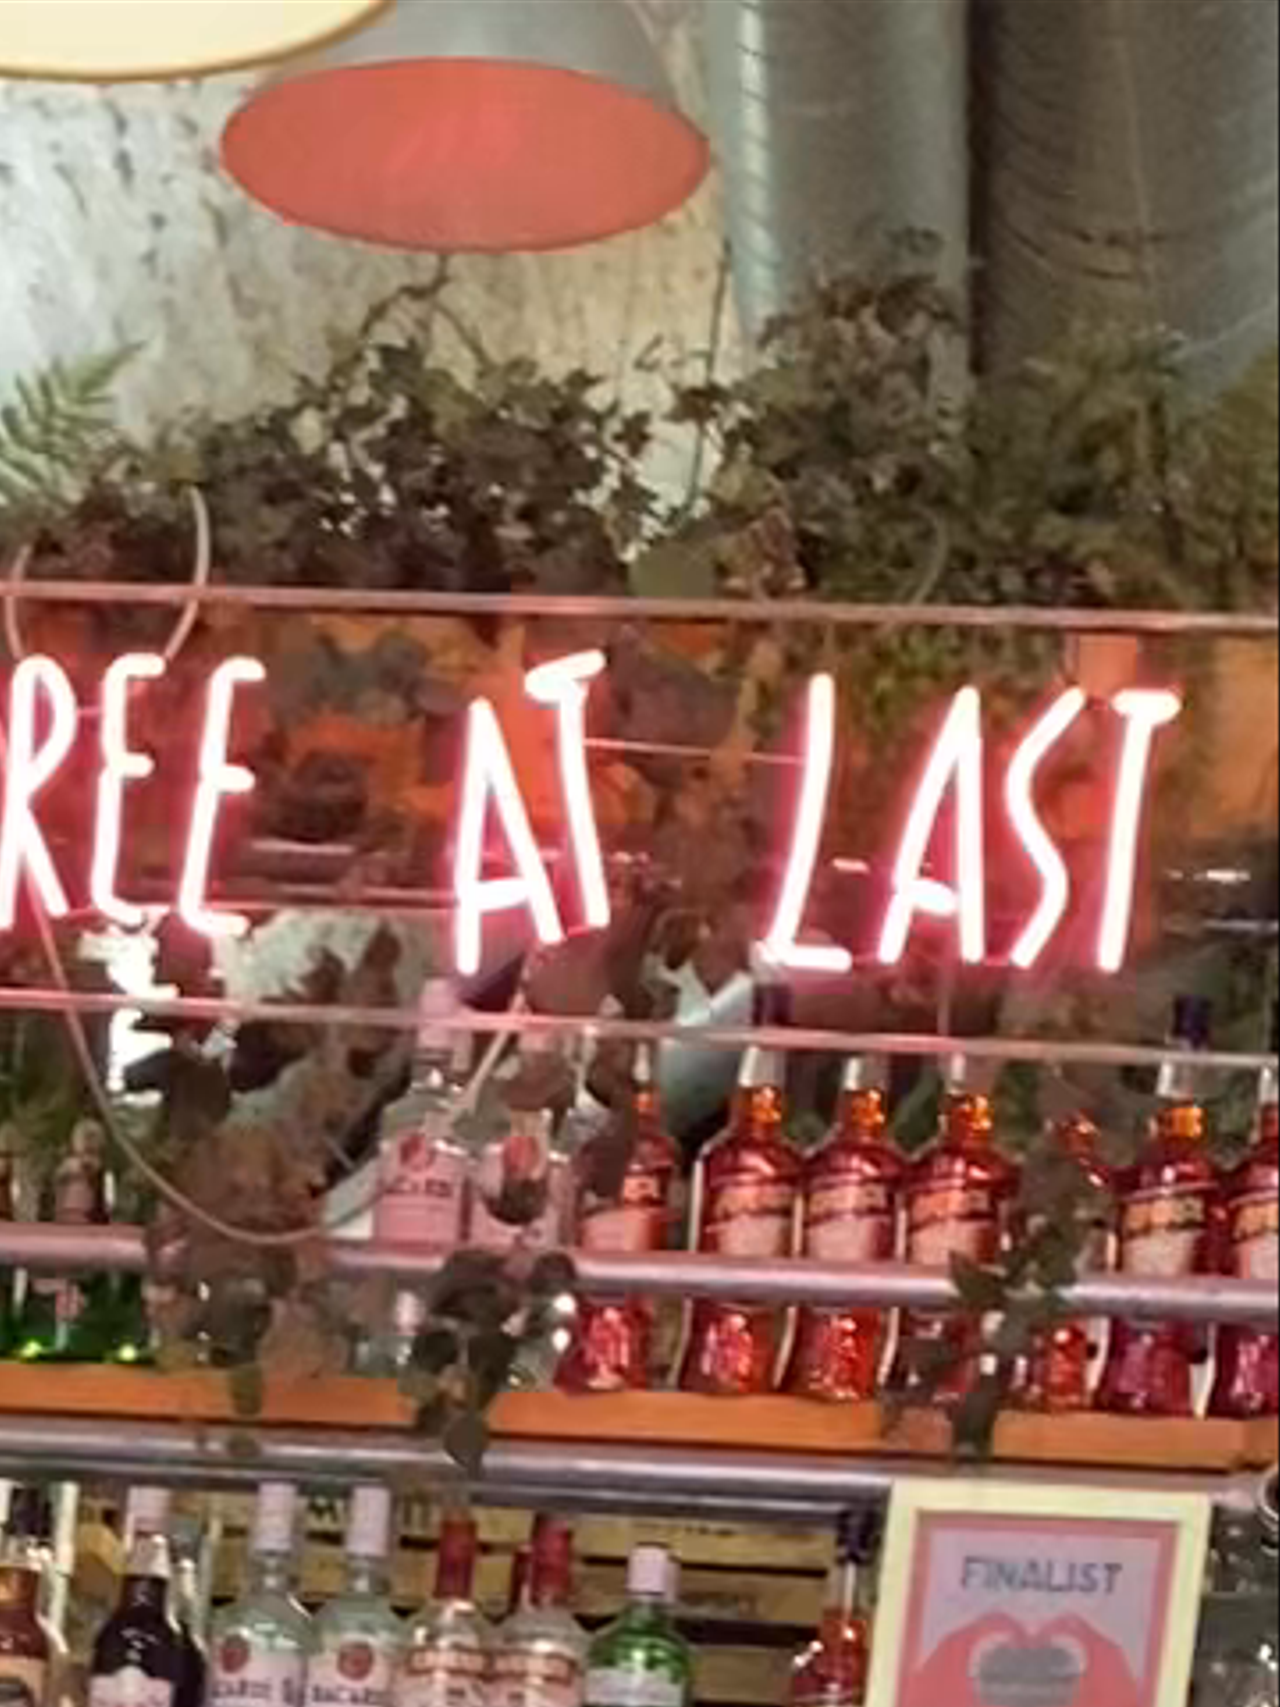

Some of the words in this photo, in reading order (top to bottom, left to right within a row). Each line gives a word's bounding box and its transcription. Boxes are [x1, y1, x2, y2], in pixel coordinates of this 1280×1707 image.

[454, 652, 611, 973] AT
[757, 672, 1181, 974] LAST
[960, 1555, 1124, 1595] FINALIST
